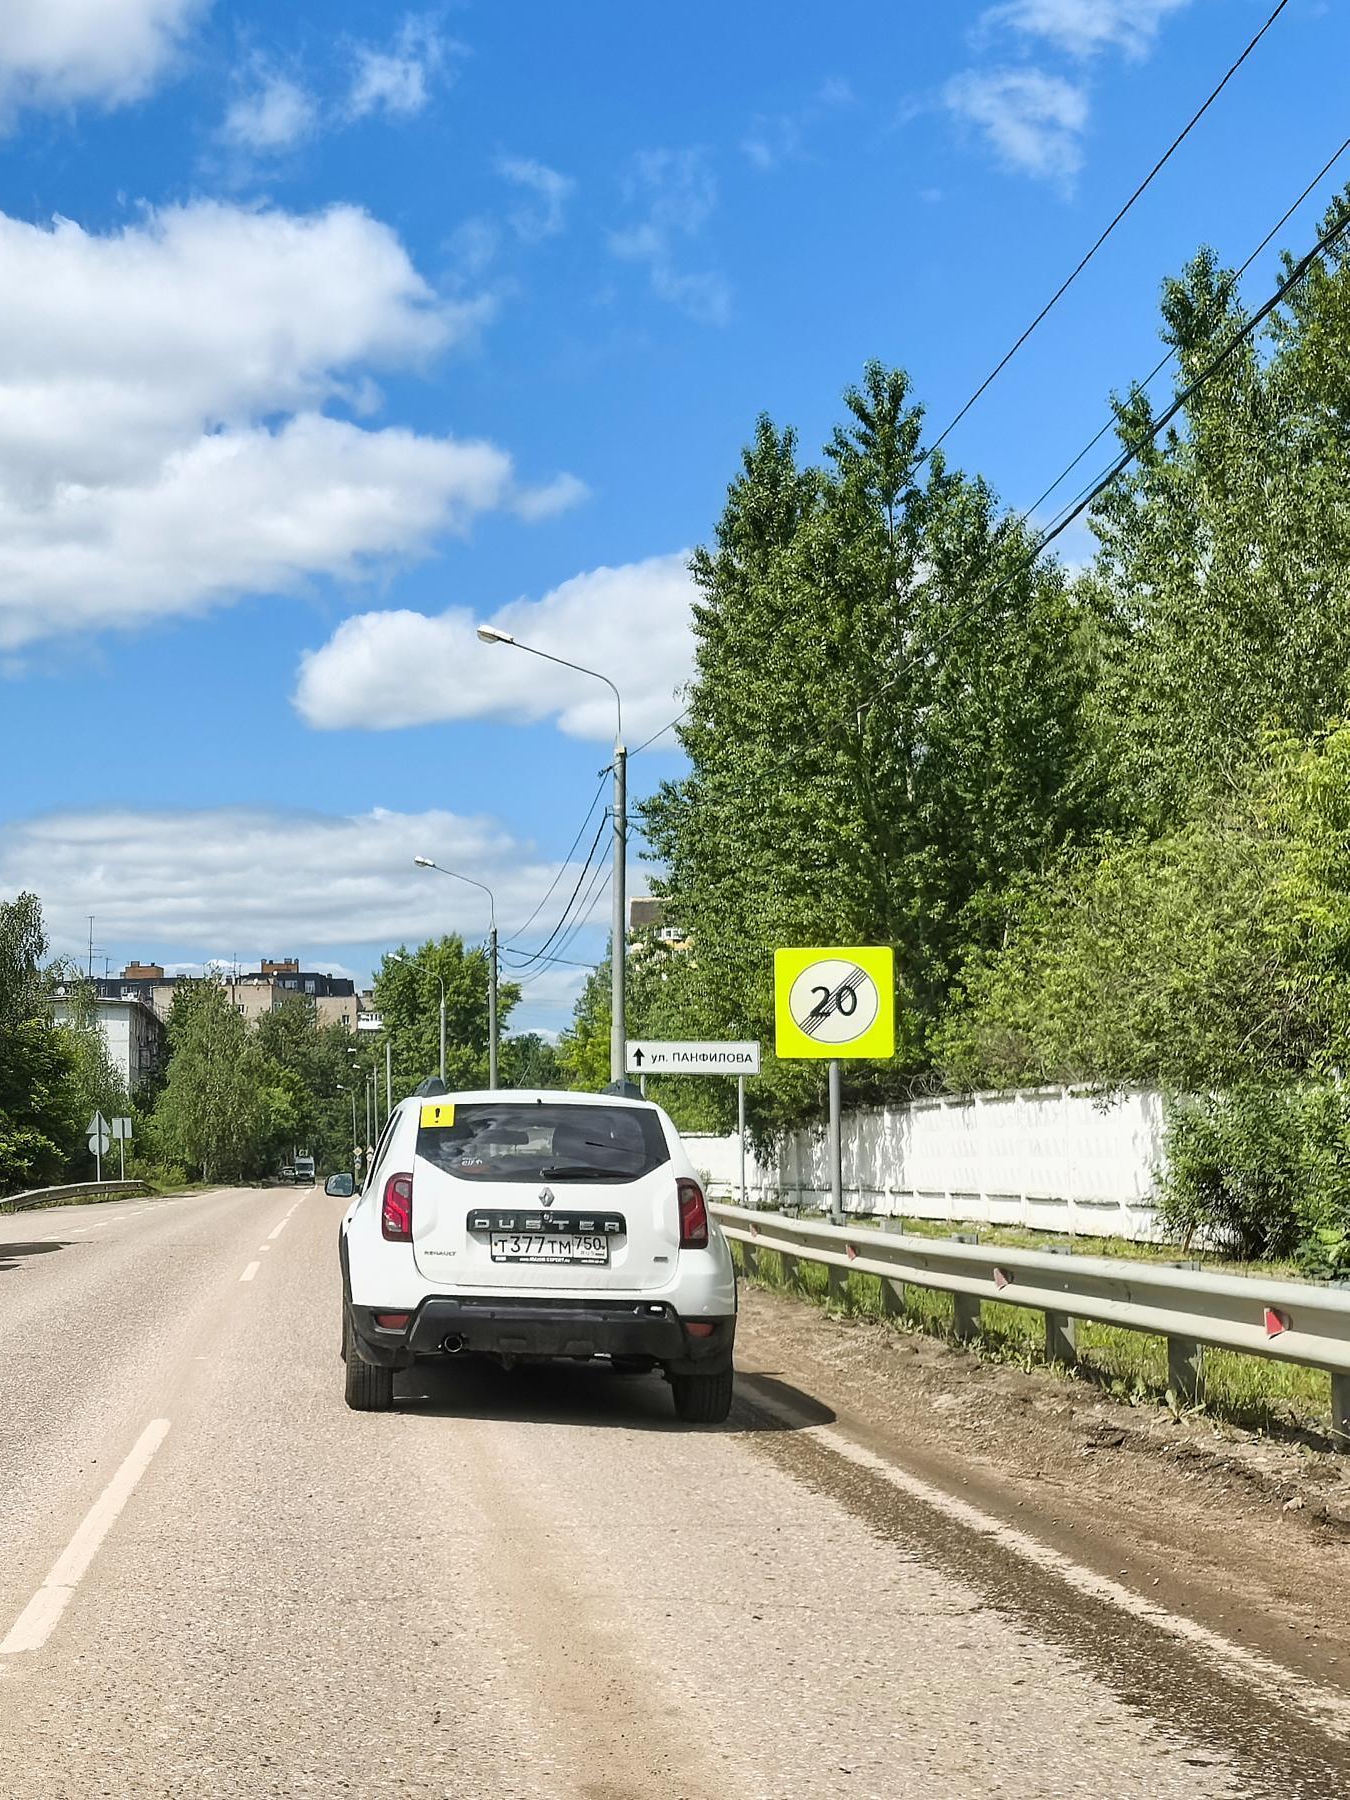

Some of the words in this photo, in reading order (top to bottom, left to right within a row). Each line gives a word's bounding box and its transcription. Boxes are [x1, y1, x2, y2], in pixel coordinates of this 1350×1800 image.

[809, 985, 857, 1017] 20
[651, 1053, 668, 1065] ул.
[672, 1051, 753, 1064] ПАНФИЛОВА
[473, 1219, 620, 1232] DUSTER
[573, 1236, 602, 1251] 750
